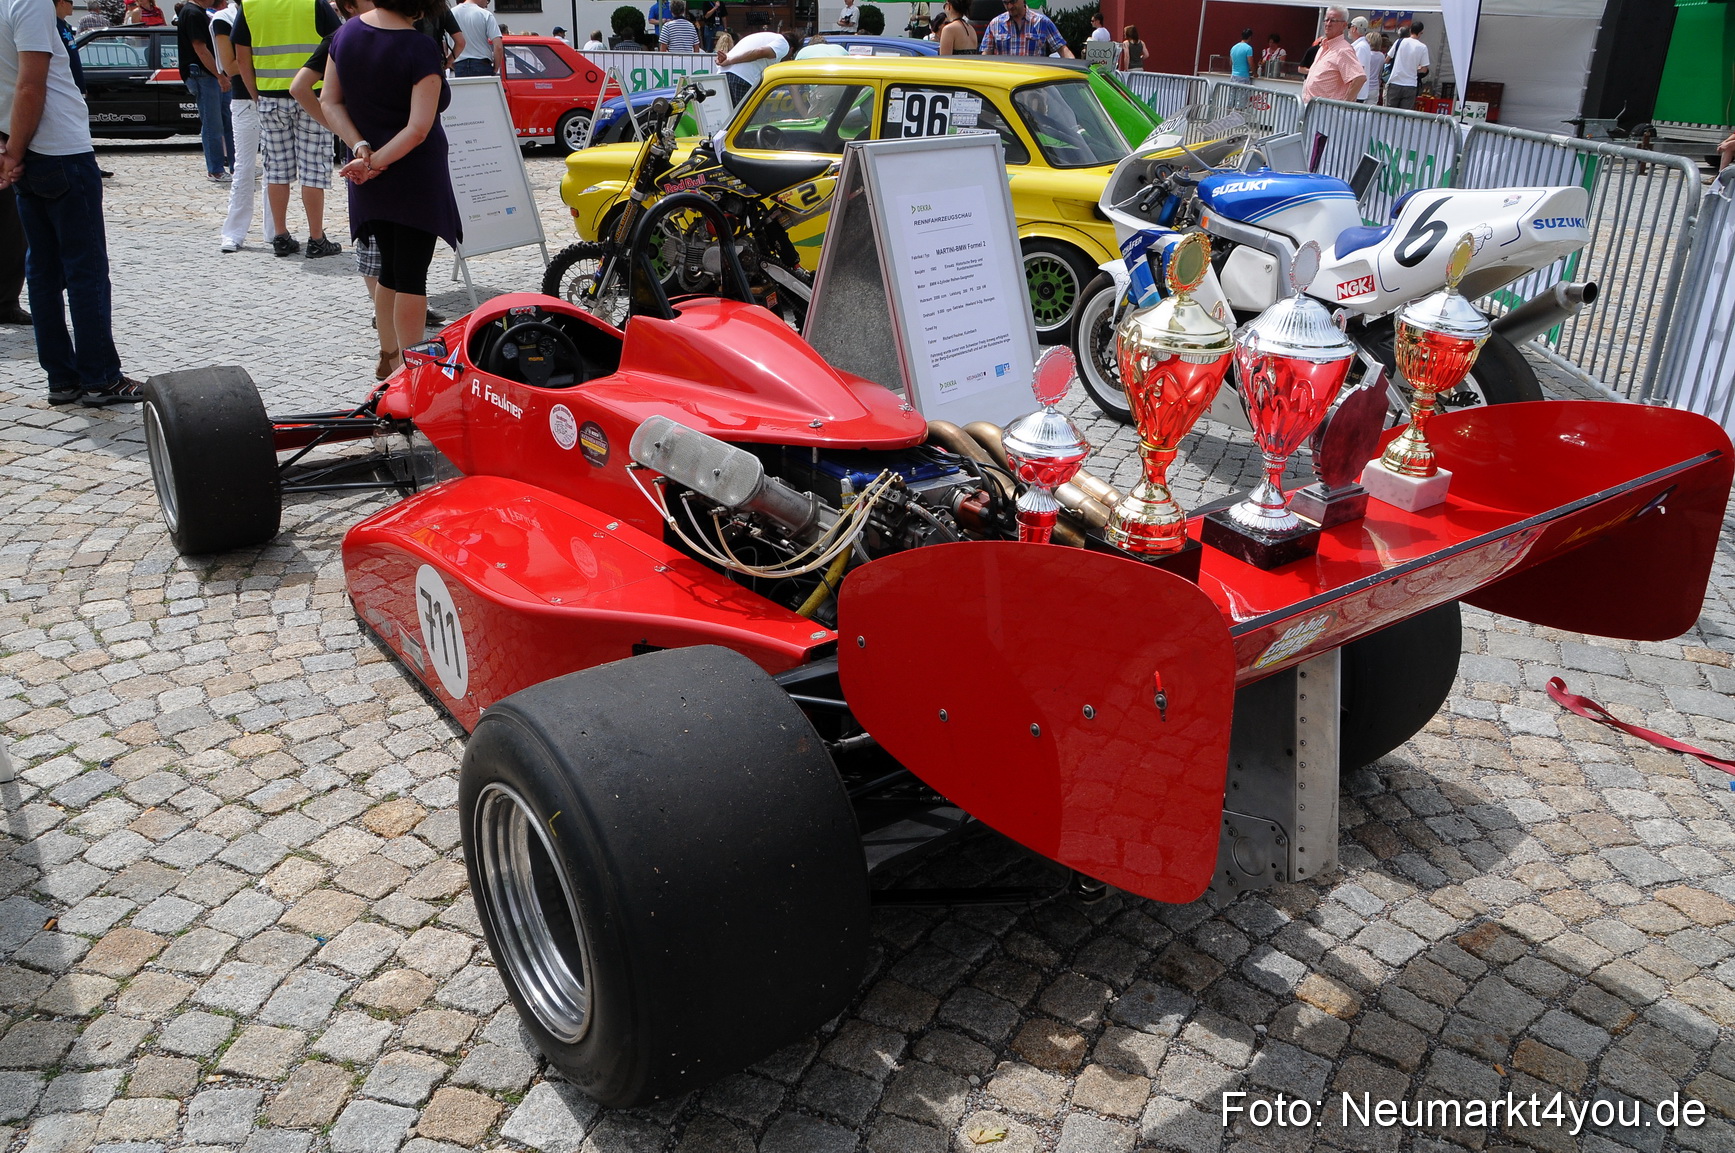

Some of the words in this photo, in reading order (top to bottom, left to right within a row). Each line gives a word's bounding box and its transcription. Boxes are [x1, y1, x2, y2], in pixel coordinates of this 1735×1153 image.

[903, 93, 950, 138] 96
[664, 181, 685, 194] Red
[685, 174, 706, 190] Bull
[1212, 180, 1270, 198] SUZUKI
[797, 183, 822, 206] 2
[917, 204, 932, 212] DEKRA
[914, 212, 972, 226] RENNFAHRZEUGSCHAU
[1532, 217, 1586, 230] SUZUKI
[1394, 196, 1454, 268] 6
[936, 245, 967, 256] MARTINI-BMW
[967, 241, 983, 250] Formel
[484, 384, 523, 420] Feulner
[420, 586, 462, 680] 711
